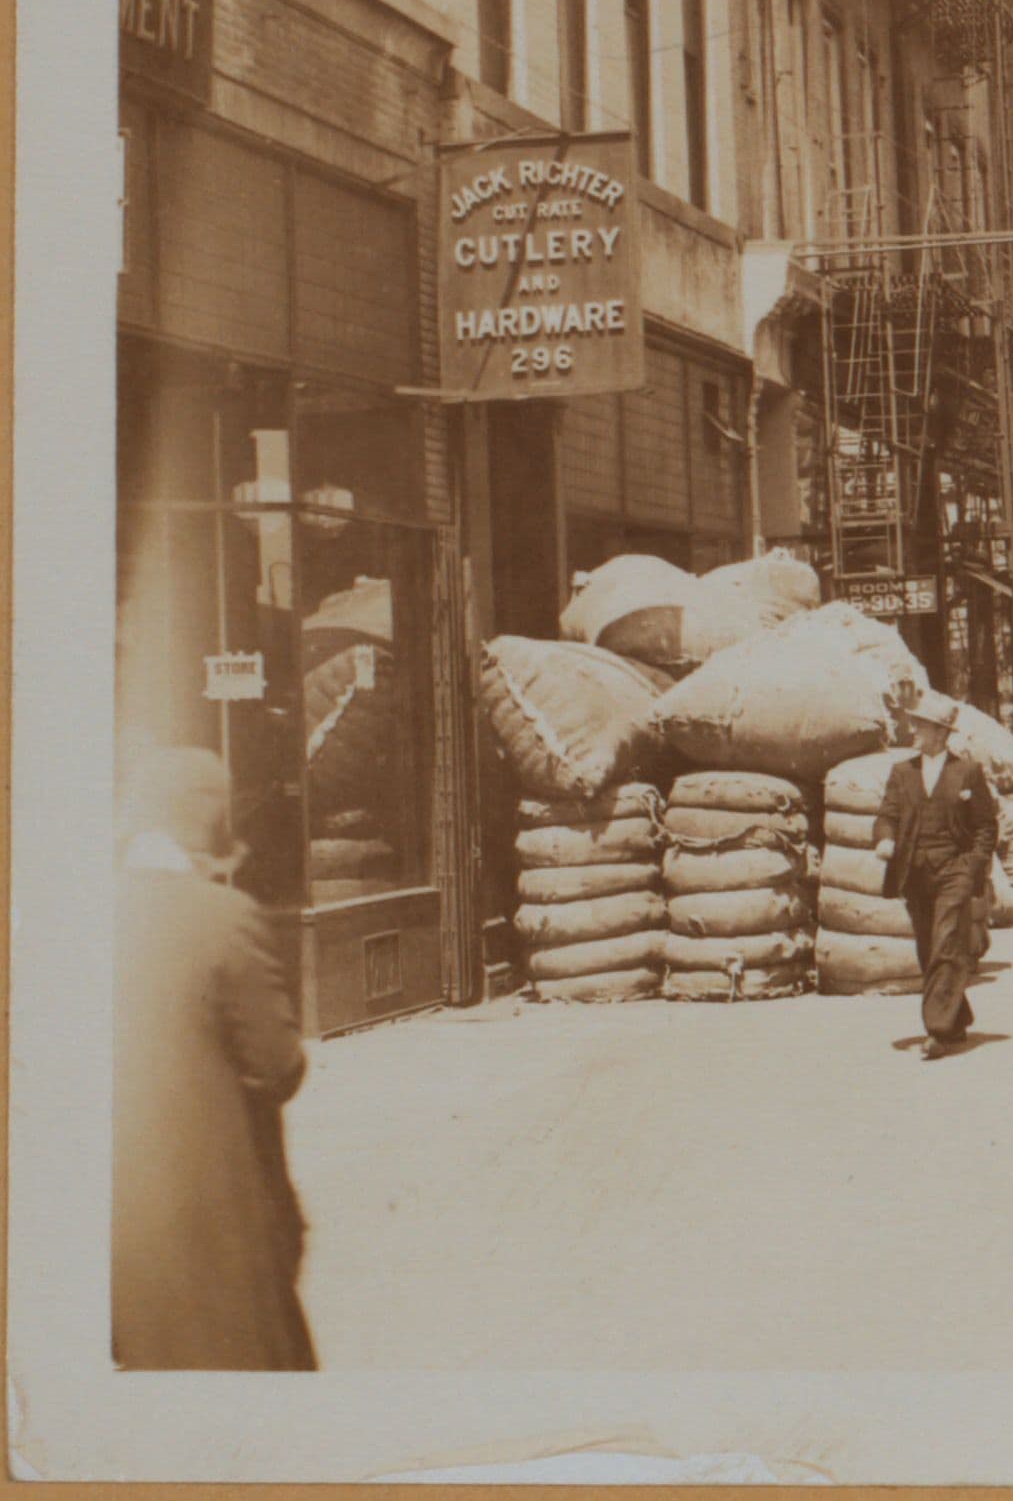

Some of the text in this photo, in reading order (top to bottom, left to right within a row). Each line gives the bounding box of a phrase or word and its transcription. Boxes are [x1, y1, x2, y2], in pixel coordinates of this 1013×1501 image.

[452, 160, 624, 220] JACK RICHTER
[492, 199, 583, 221] CUT RATE
[454, 227, 620, 267] CUTLERY
[518, 274, 560, 293] AND
[455, 299, 625, 341] HARDWARE
[511, 345, 574, 373] 296
[848, 580, 918, 594] ROOMS
